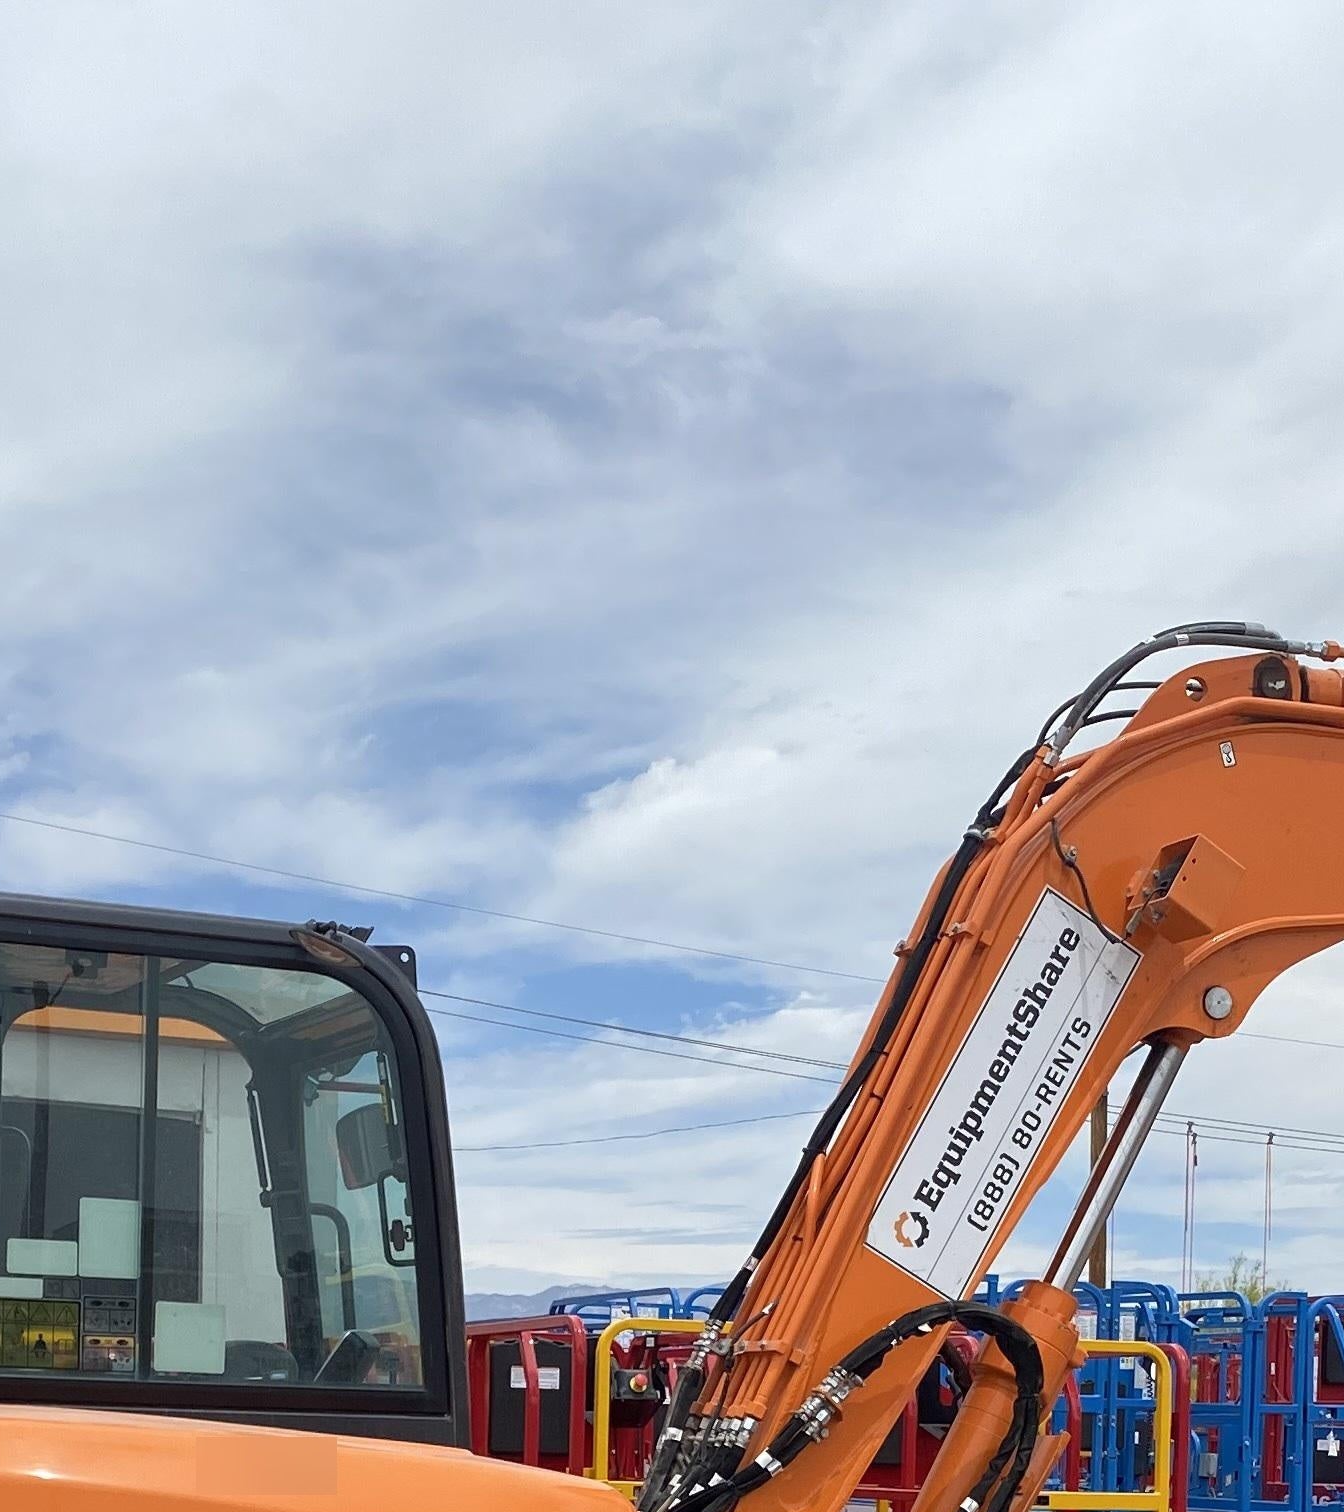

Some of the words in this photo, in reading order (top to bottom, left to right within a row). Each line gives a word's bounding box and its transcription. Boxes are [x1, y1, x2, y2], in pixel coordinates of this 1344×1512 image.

[913, 927, 1080, 1212] EquipmentShare
[967, 1152, 1020, 1232] (888)
[1011, 1017, 1091, 1150] 80-RENTS
